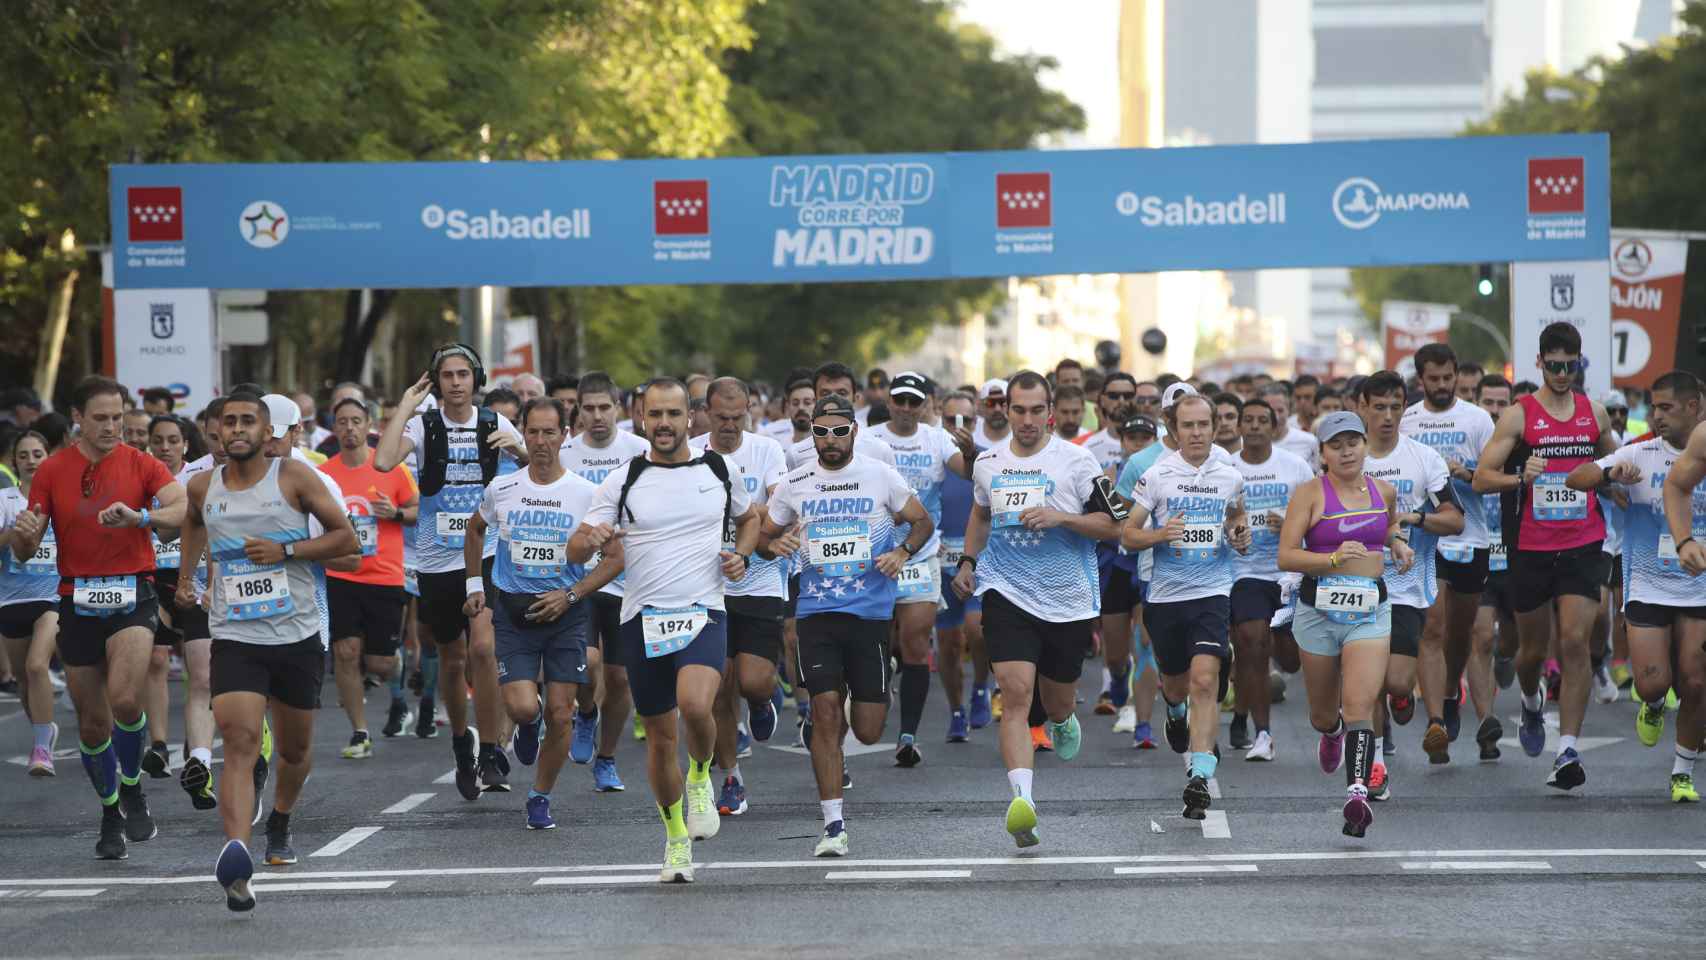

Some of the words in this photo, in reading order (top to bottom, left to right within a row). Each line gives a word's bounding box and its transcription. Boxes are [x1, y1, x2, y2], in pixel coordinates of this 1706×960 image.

[770, 163, 934, 206] MADRID
[1376, 192, 1470, 211] MAPOMA
[800, 206, 862, 225] CORRE
[866, 206, 902, 224] POR
[1141, 192, 1287, 227] Sabadell
[445, 209, 591, 240] Sabadell
[1545, 228, 1586, 240] Madrid
[773, 227, 934, 267] MADRID
[1611, 283, 1662, 311] AJÓN
[140, 344, 186, 355] MADRID
[448, 436, 476, 444] Sabade
[820, 482, 859, 493] Sabadell
[1183, 484, 1218, 494] Sabadell
[526, 498, 562, 508] Sabadell
[1006, 492, 1028, 506] 737
[1545, 489, 1577, 503] 3135
[801, 497, 874, 517] MADRID
[449, 518, 470, 531] 280
[507, 510, 574, 530] MADRID
[1251, 514, 1266, 527] 28
[820, 525, 860, 536] Sabadell
[1182, 529, 1214, 543] 3388
[523, 546, 554, 561] 2793
[822, 541, 856, 558] 8547
[235, 578, 273, 598] 1868
[87, 591, 122, 604] 2038
[1329, 591, 1364, 607] 2741
[658, 619, 693, 635] 1974
